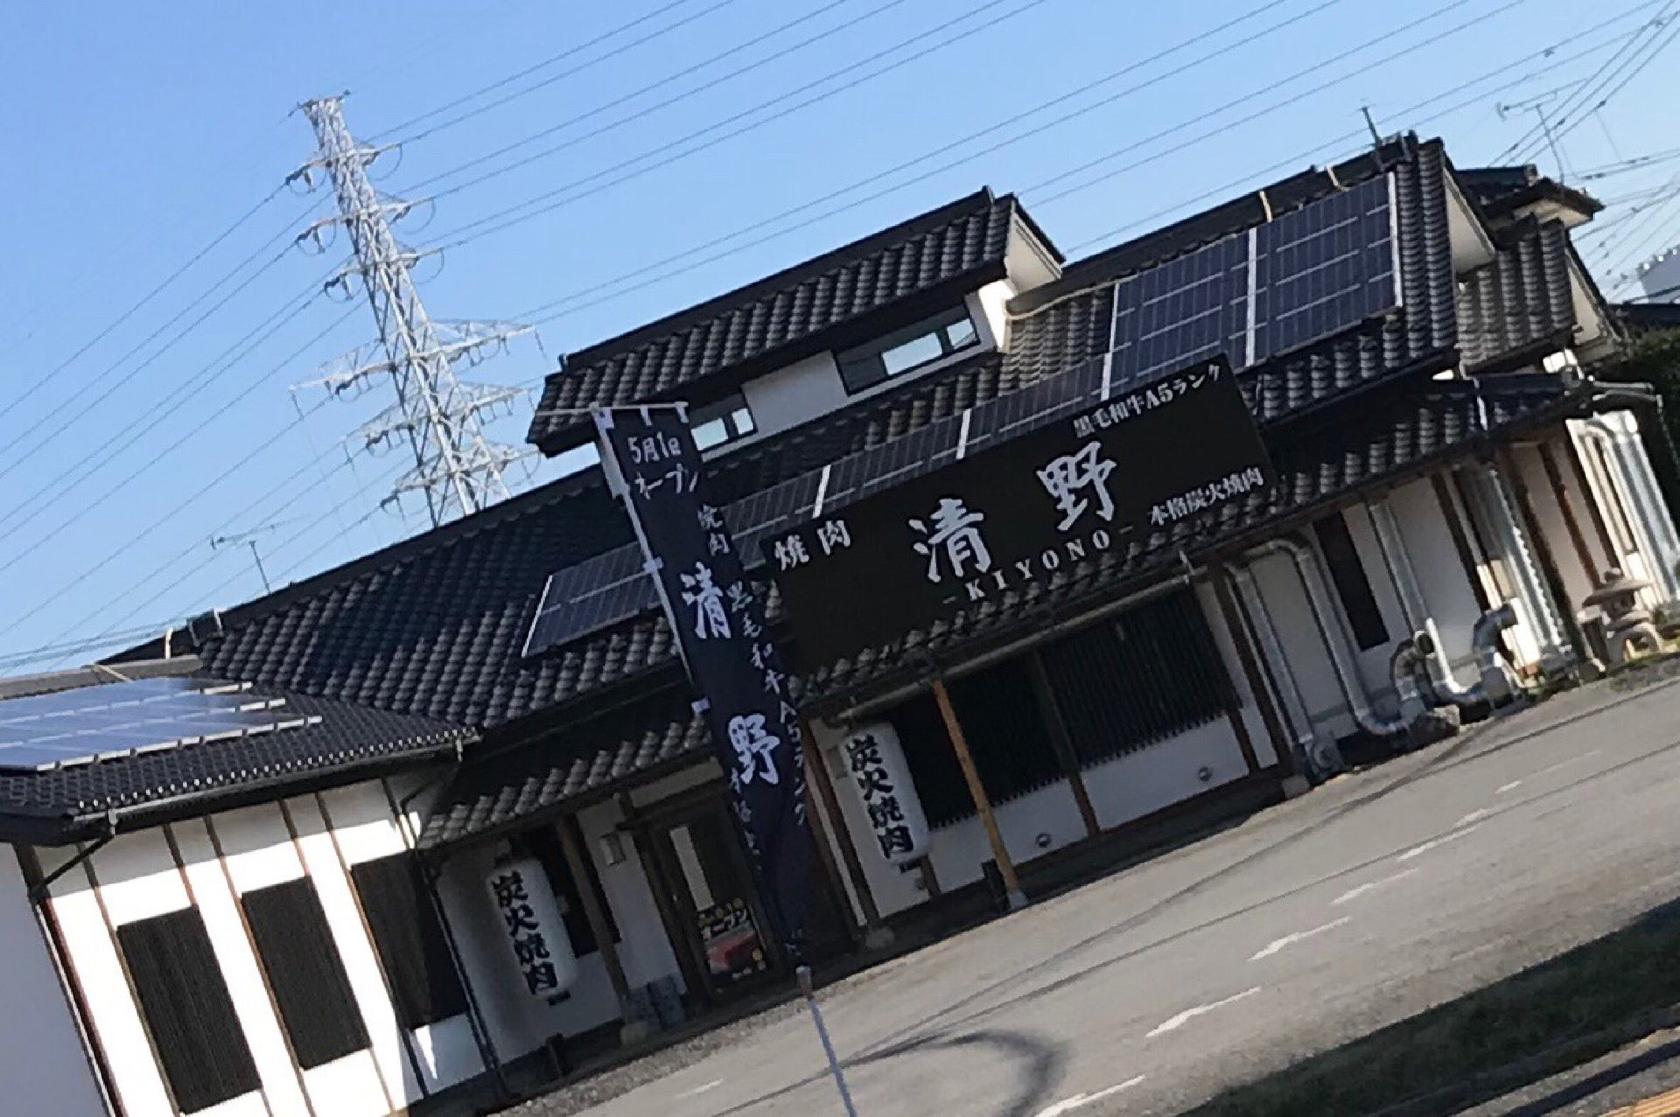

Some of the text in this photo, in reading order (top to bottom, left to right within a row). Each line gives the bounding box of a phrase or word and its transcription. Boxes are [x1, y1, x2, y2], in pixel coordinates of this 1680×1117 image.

[1073, 364, 1220, 438] 黒毛和牛A5ランク
[627, 431, 682, 464] 5月1日
[908, 440, 1117, 583] 清野
[1148, 466, 1264, 526] 本格炭火焼肉
[698, 504, 730, 557] 焼肉
[773, 520, 852, 572] 焼肉
[846, 733, 914, 859] 炭火焼肉
[491, 869, 558, 995] 炭火焼肉
